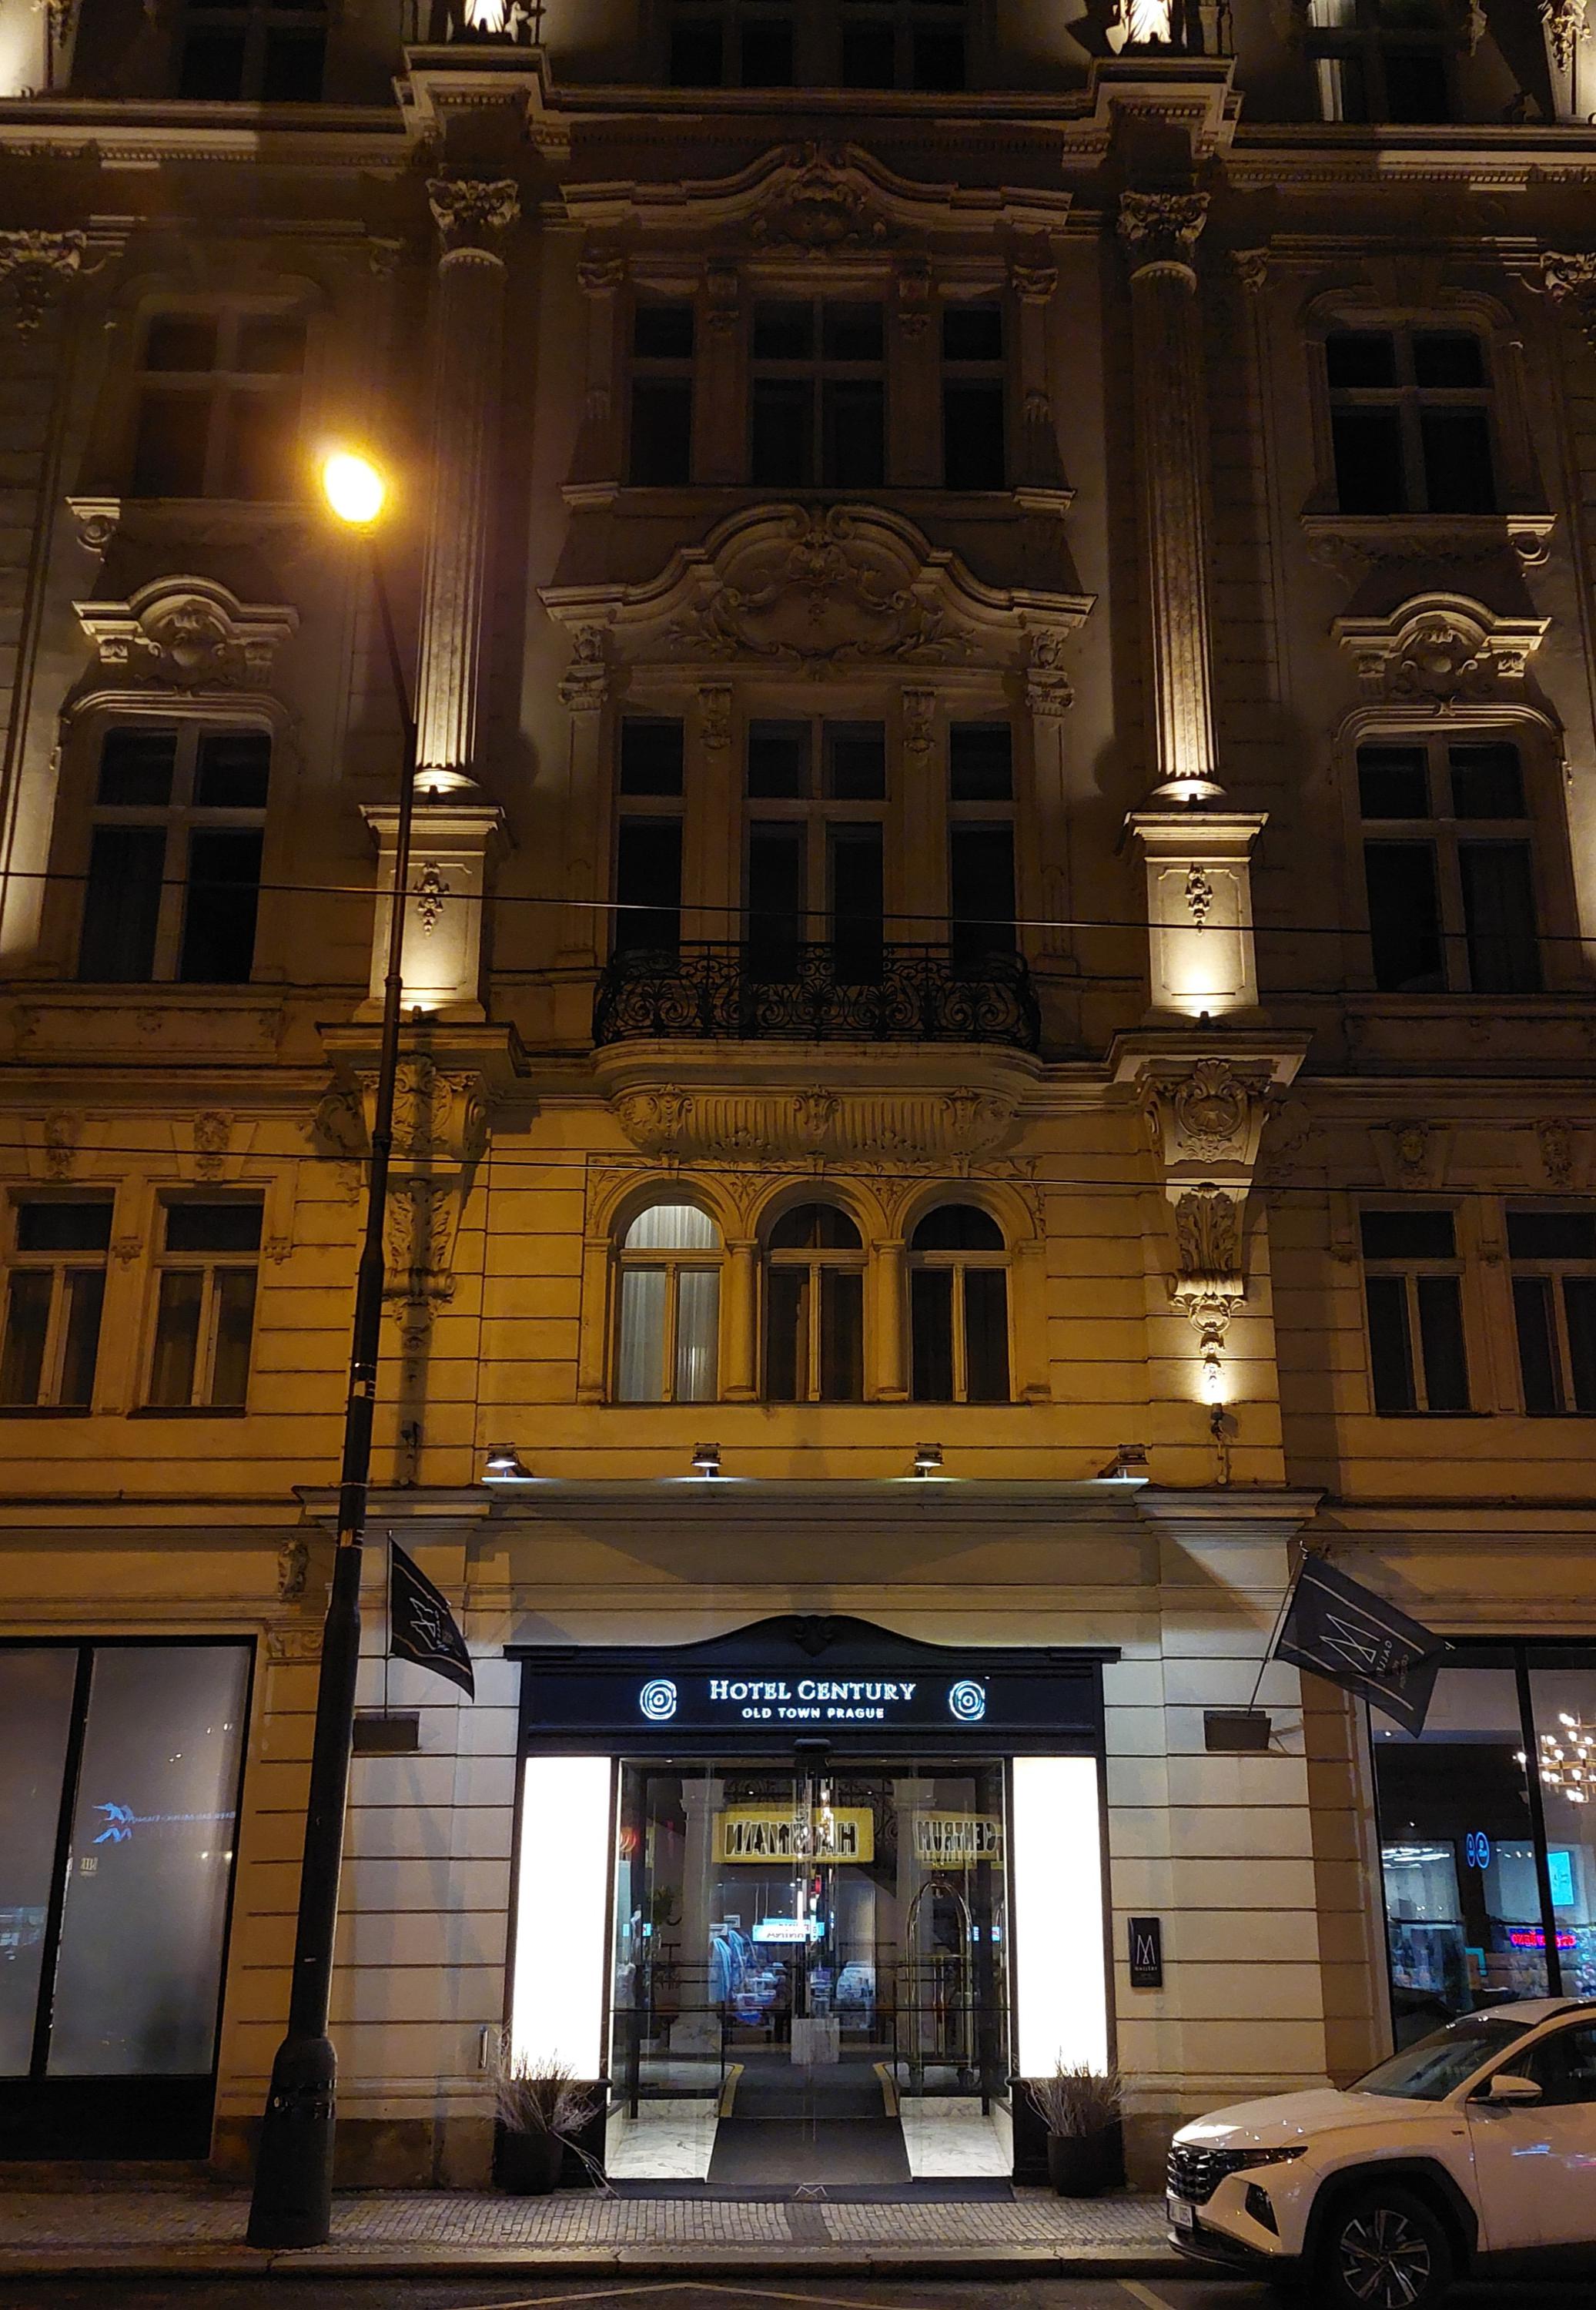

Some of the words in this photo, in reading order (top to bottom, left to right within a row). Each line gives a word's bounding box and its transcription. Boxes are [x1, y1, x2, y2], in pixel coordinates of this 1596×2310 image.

[709, 1679, 791, 1700] HOTEL
[798, 1679, 917, 1700] CENTURY
[741, 1707, 771, 1719] OLD
[778, 1707, 821, 1719] TOWN
[827, 1707, 885, 1719] PRAGUE
